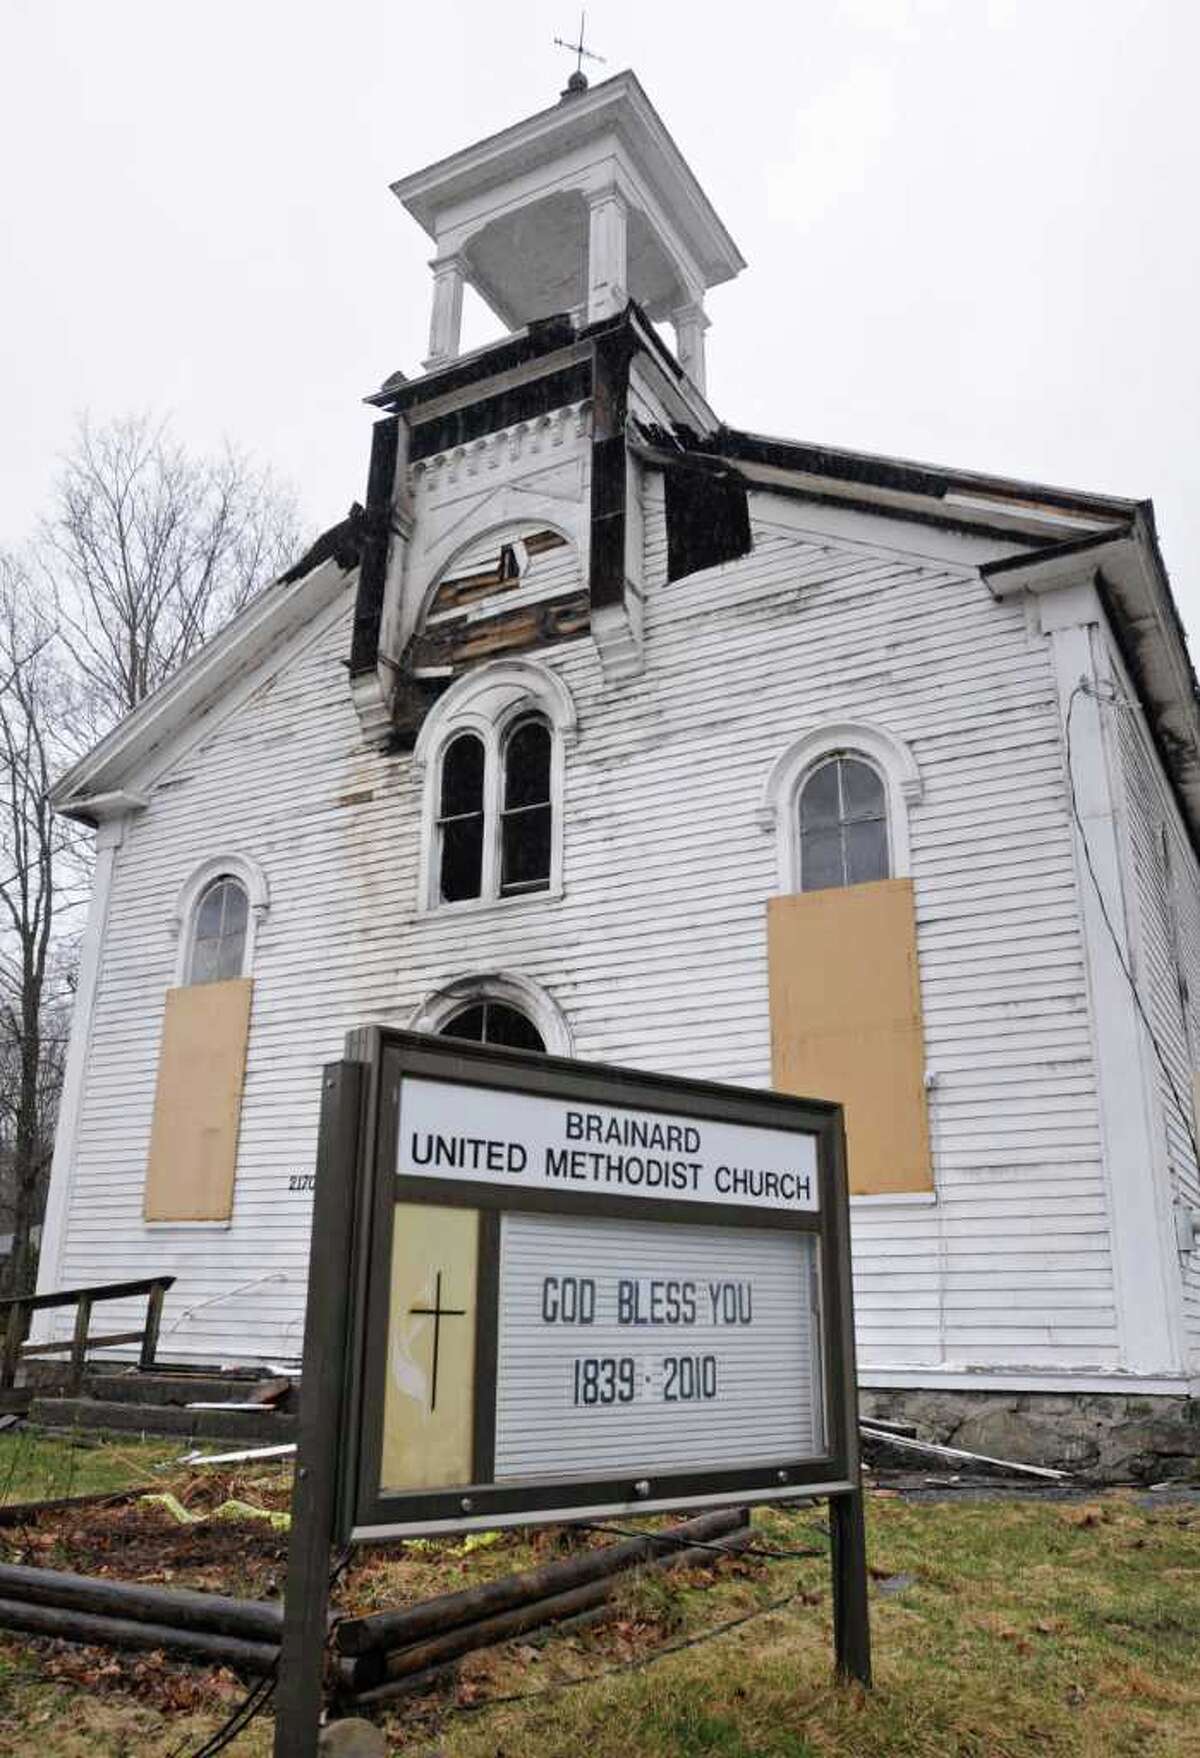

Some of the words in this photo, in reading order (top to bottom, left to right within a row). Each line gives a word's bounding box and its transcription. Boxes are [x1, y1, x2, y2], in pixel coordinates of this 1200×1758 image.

[566, 1112, 701, 1154] BRAINARD
[411, 1133, 527, 1173] UNITED
[545, 1148, 703, 1191] METHODIST
[715, 1166, 810, 1201] CHURCH
[542, 1277, 596, 1324] GOD
[618, 1280, 696, 1324] BLESS
[708, 1283, 752, 1324] YOU
[574, 1357, 635, 1405] 1839
[664, 1356, 716, 1401] 2010
